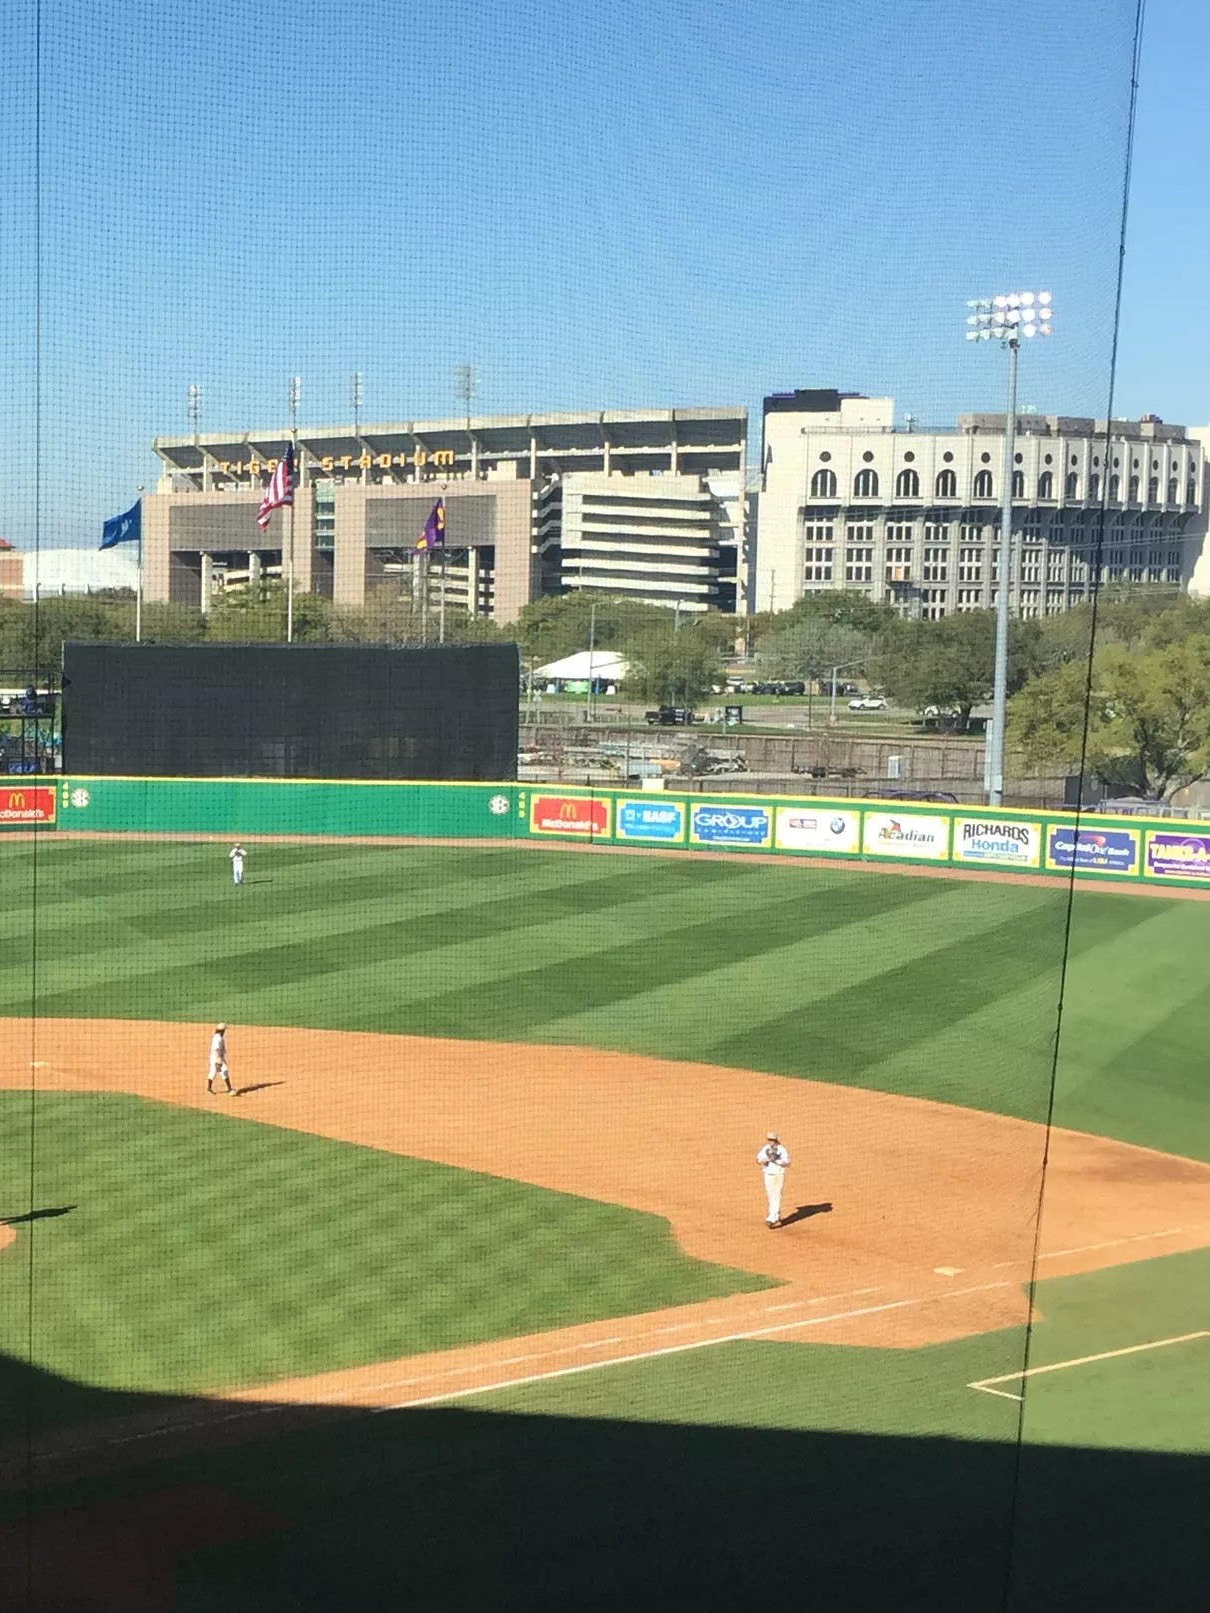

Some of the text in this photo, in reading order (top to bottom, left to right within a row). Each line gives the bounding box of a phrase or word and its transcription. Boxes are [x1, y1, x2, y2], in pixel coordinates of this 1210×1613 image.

[220, 449, 454, 475] TIGE STADIUM
[541, 818, 599, 831] McDonald's
[694, 811, 768, 829] GROUP
[878, 827, 935, 843] Acadian
[963, 823, 1030, 845] RICHARDS
[971, 838, 1020, 854] Honda
